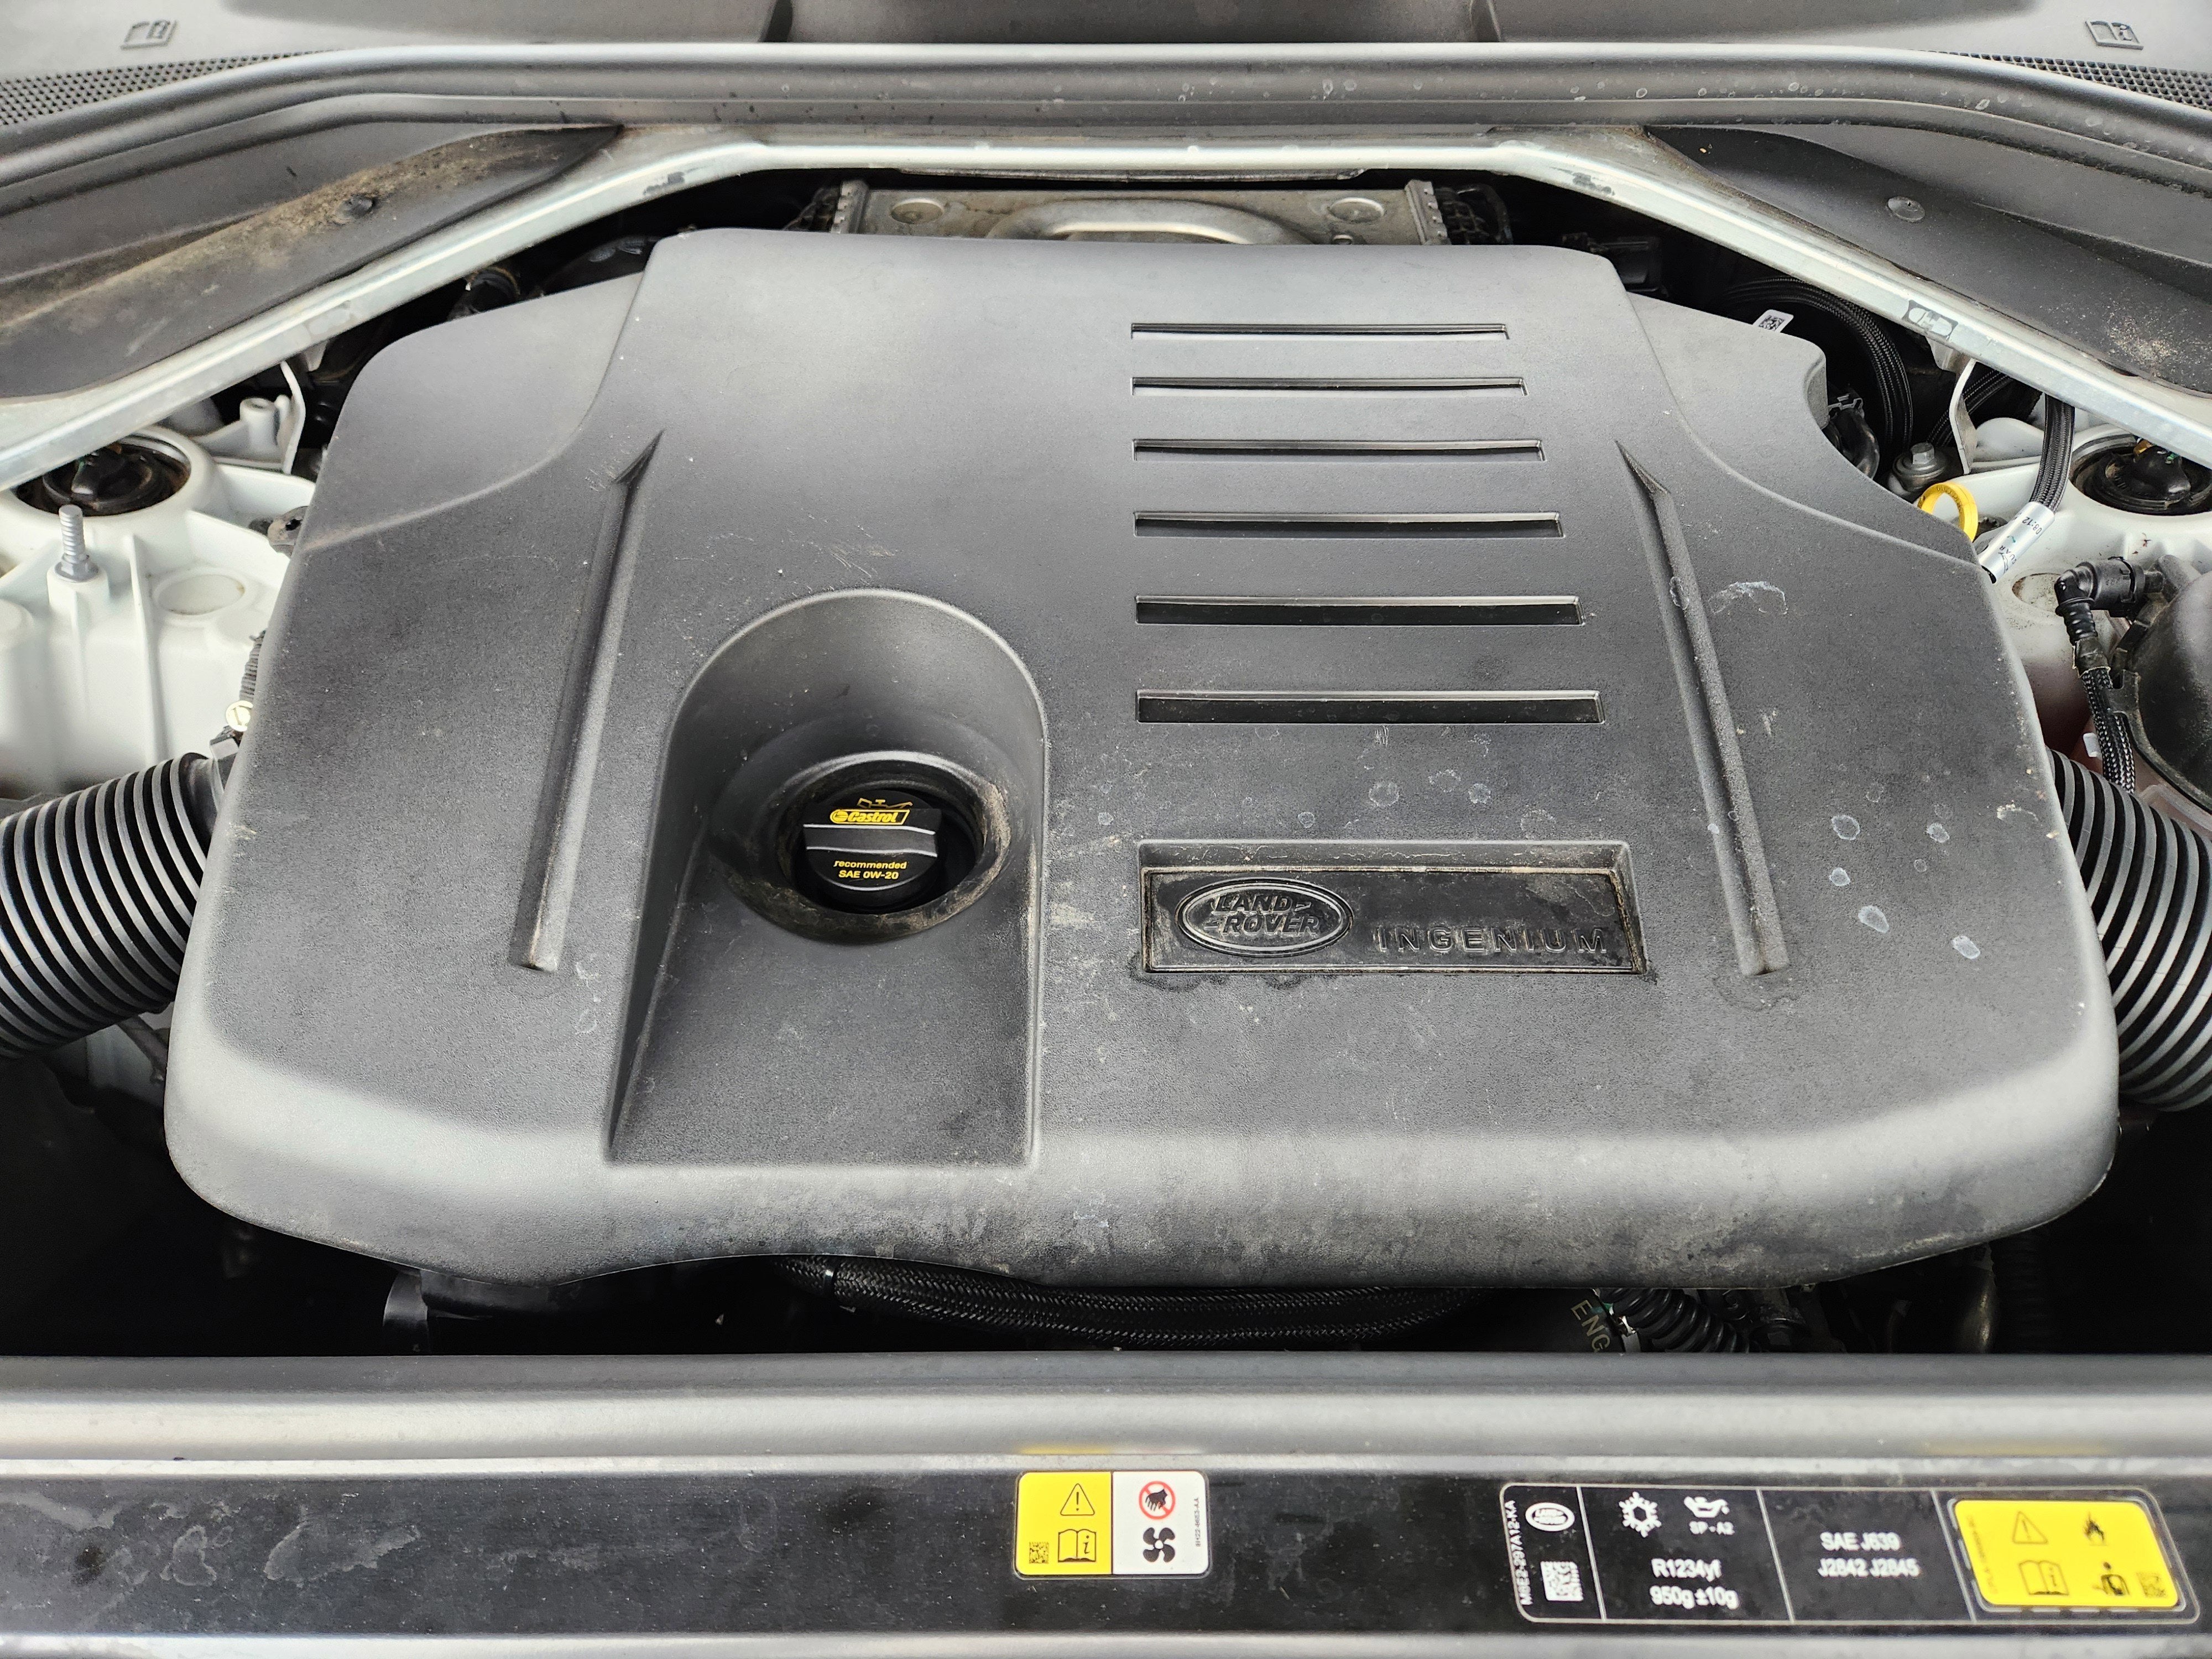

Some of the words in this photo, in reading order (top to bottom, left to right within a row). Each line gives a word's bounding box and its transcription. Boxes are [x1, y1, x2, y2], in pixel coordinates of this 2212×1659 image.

[2022, 516, 2042, 535] 08:12
[847, 811, 897, 823] Castrol
[833, 860, 907, 870] recommended
[863, 871, 899, 880] 0W-20
[1214, 893, 1292, 912] LAND
[1221, 914, 1321, 936] ROVER
[1378, 926, 1608, 954] INGENIUM
[1820, 1531, 1860, 1551] SAE
[1651, 1558, 1723, 1582] R1234yf
